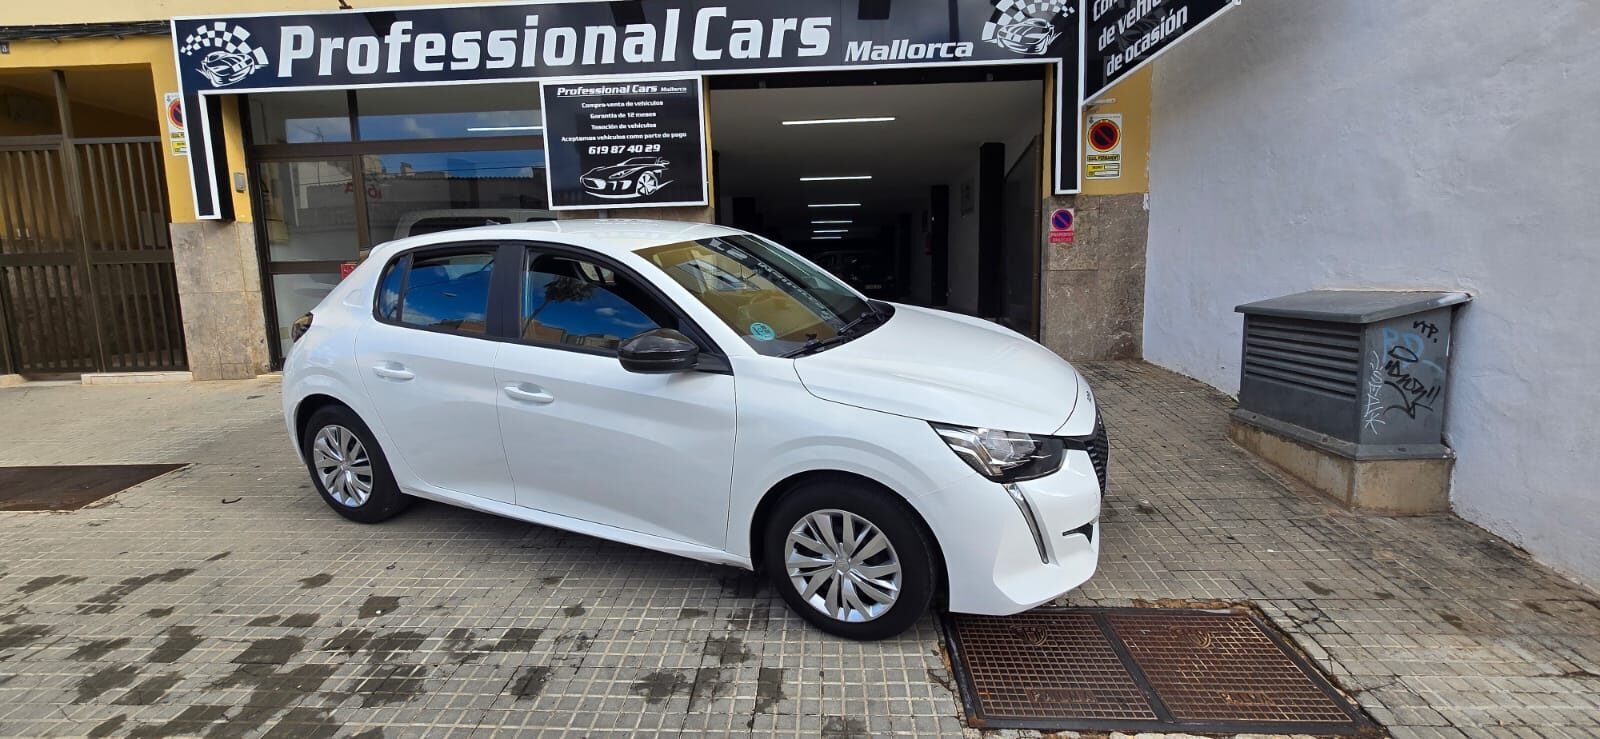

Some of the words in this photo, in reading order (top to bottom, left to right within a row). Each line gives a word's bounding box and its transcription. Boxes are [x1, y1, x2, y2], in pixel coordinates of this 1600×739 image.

[277, 8, 680, 78] Professional
[692, 6, 832, 61] Cars
[844, 39, 974, 62] Mallorca
[1098, 25, 1116, 52] de
[1106, 53, 1123, 77] de
[1125, 5, 1188, 64] ocasión
[556, 84, 630, 96] Professional
[632, 84, 658, 94] Cars
[588, 146, 609, 155] 619
[610, 145, 626, 154] 87
[627, 144, 643, 153] 40
[644, 143, 661, 153] 29
